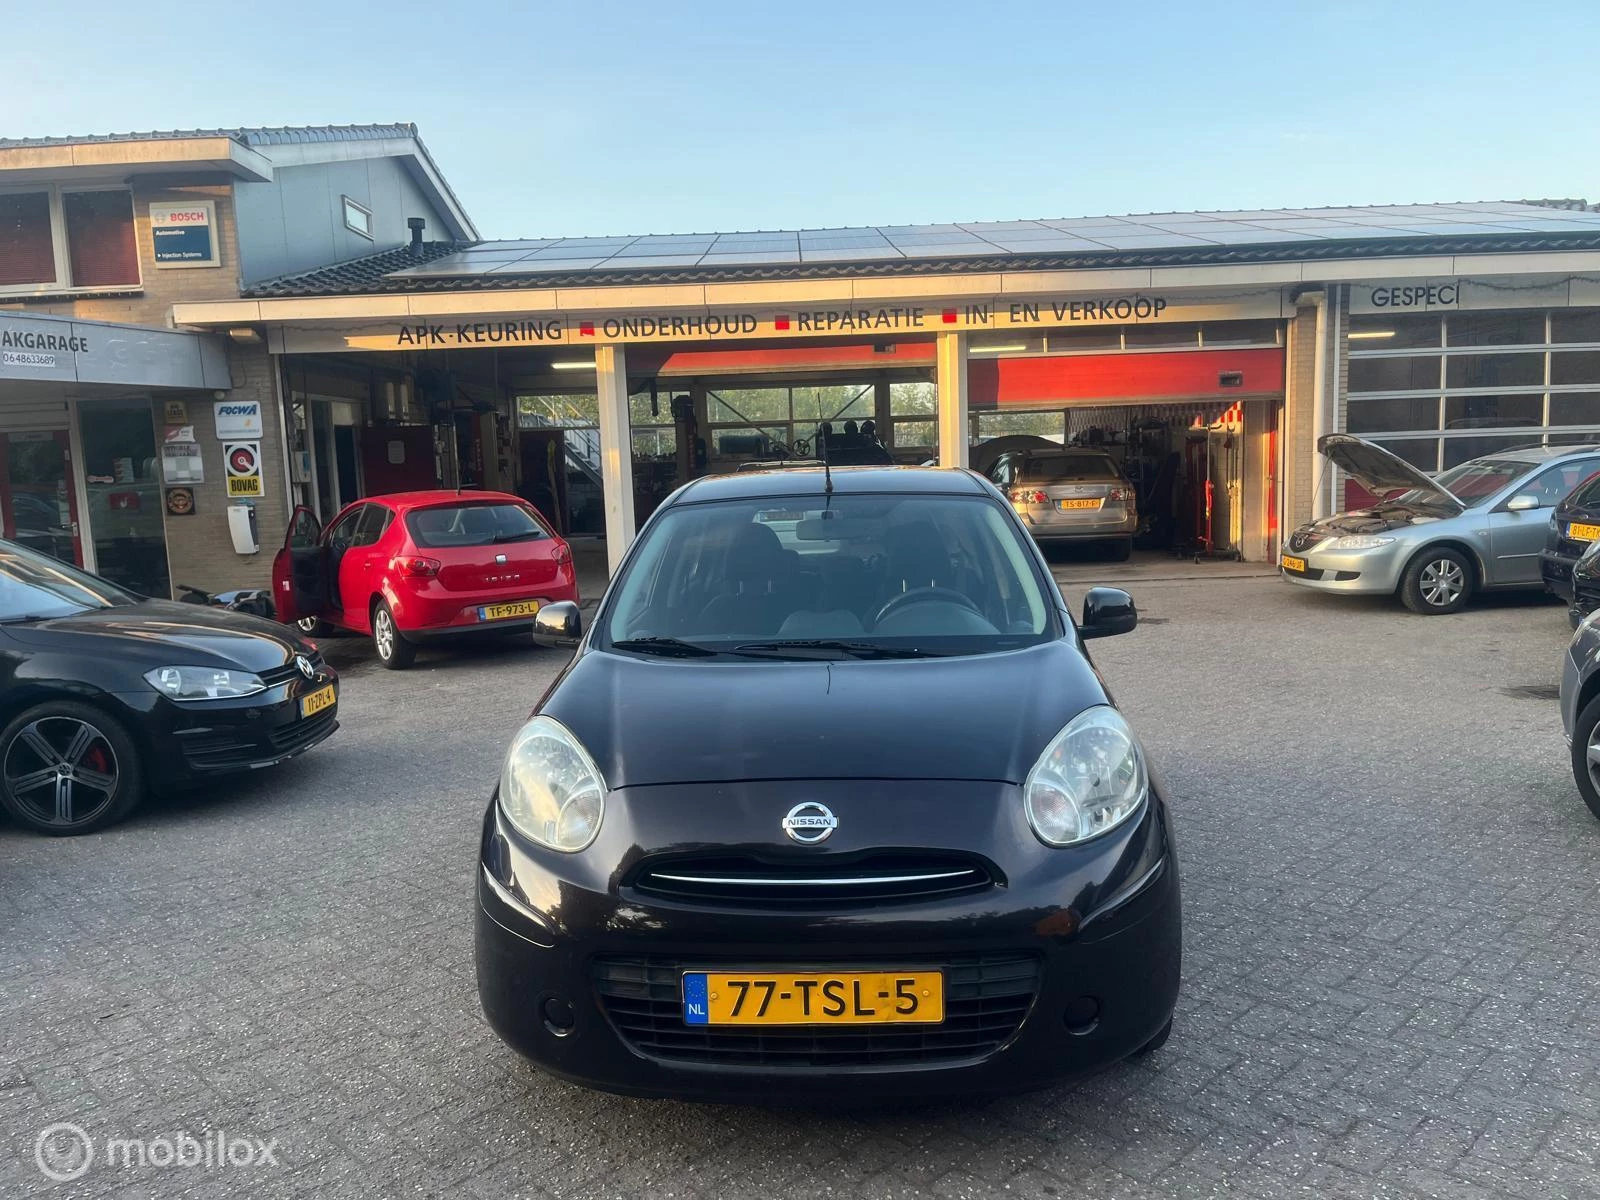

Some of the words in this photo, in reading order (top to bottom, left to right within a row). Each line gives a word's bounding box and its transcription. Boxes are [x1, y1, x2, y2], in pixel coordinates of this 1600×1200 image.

[170, 212, 204, 221] BOSCH
[398, 320, 562, 345] APK-KEURING
[603, 314, 758, 338] ONDERHOUD
[798, 307, 925, 332] REPARATIE
[1009, 302, 1040, 323] EN
[1052, 297, 1167, 321] VERKOOP
[2, 330, 89, 353] AKGARAGE
[219, 405, 257, 415] FOCWA
[231, 479, 258, 492] BOVAG
[489, 603, 535, 617] TF-973-L
[308, 689, 331, 712] 11-ZPL-4
[788, 818, 832, 826] NISSAN
[688, 1004, 705, 1015] NL
[727, 979, 919, 1017] 77-TSL-5
